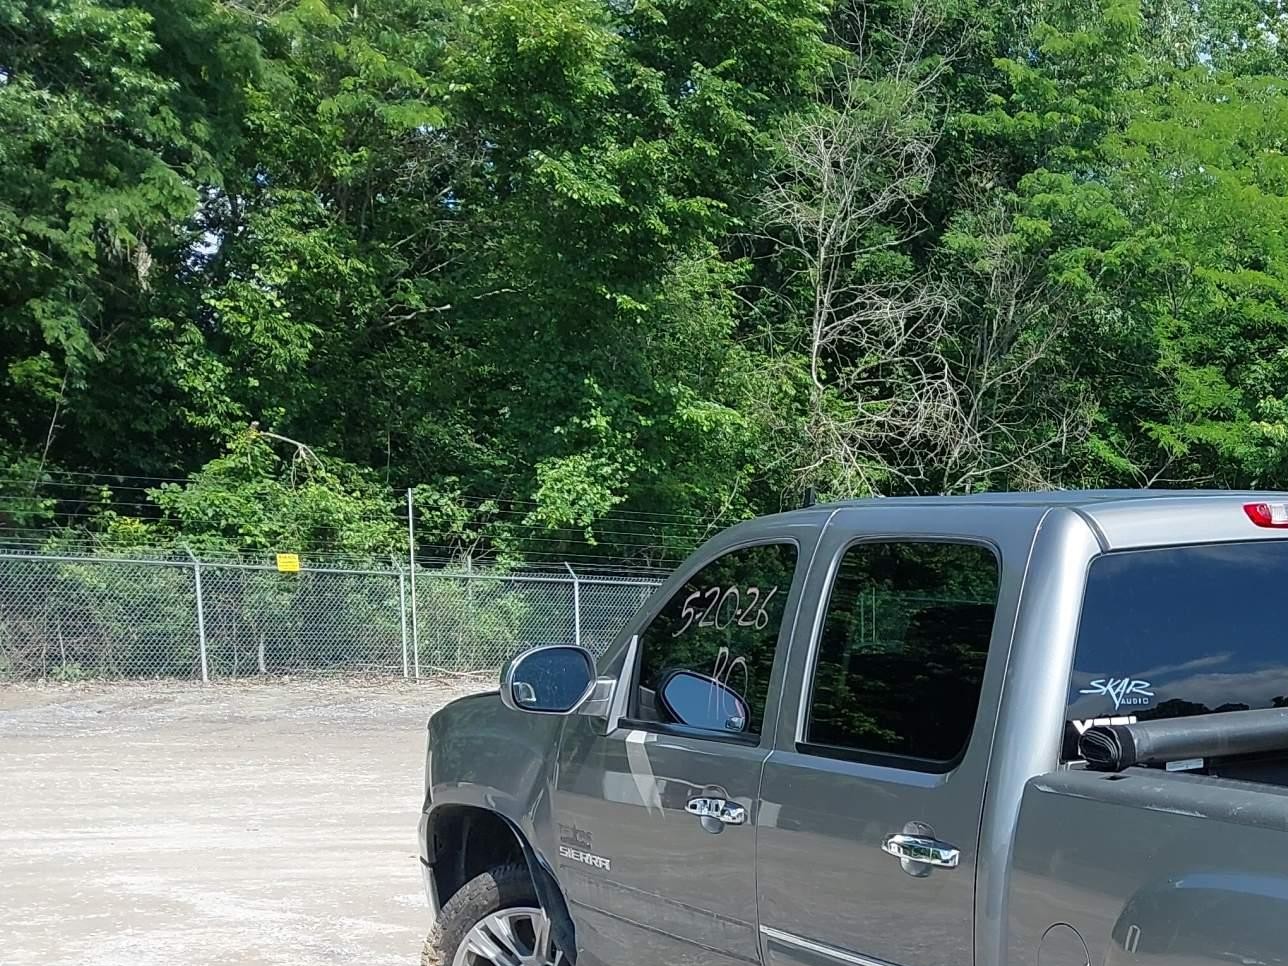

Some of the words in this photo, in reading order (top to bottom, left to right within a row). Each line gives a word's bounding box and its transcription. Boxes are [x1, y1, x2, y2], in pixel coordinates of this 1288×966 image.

[1079, 677, 1155, 711] SKAR
[1120, 697, 1149, 705] AUDIO
[559, 845, 611, 871] SIERRA
